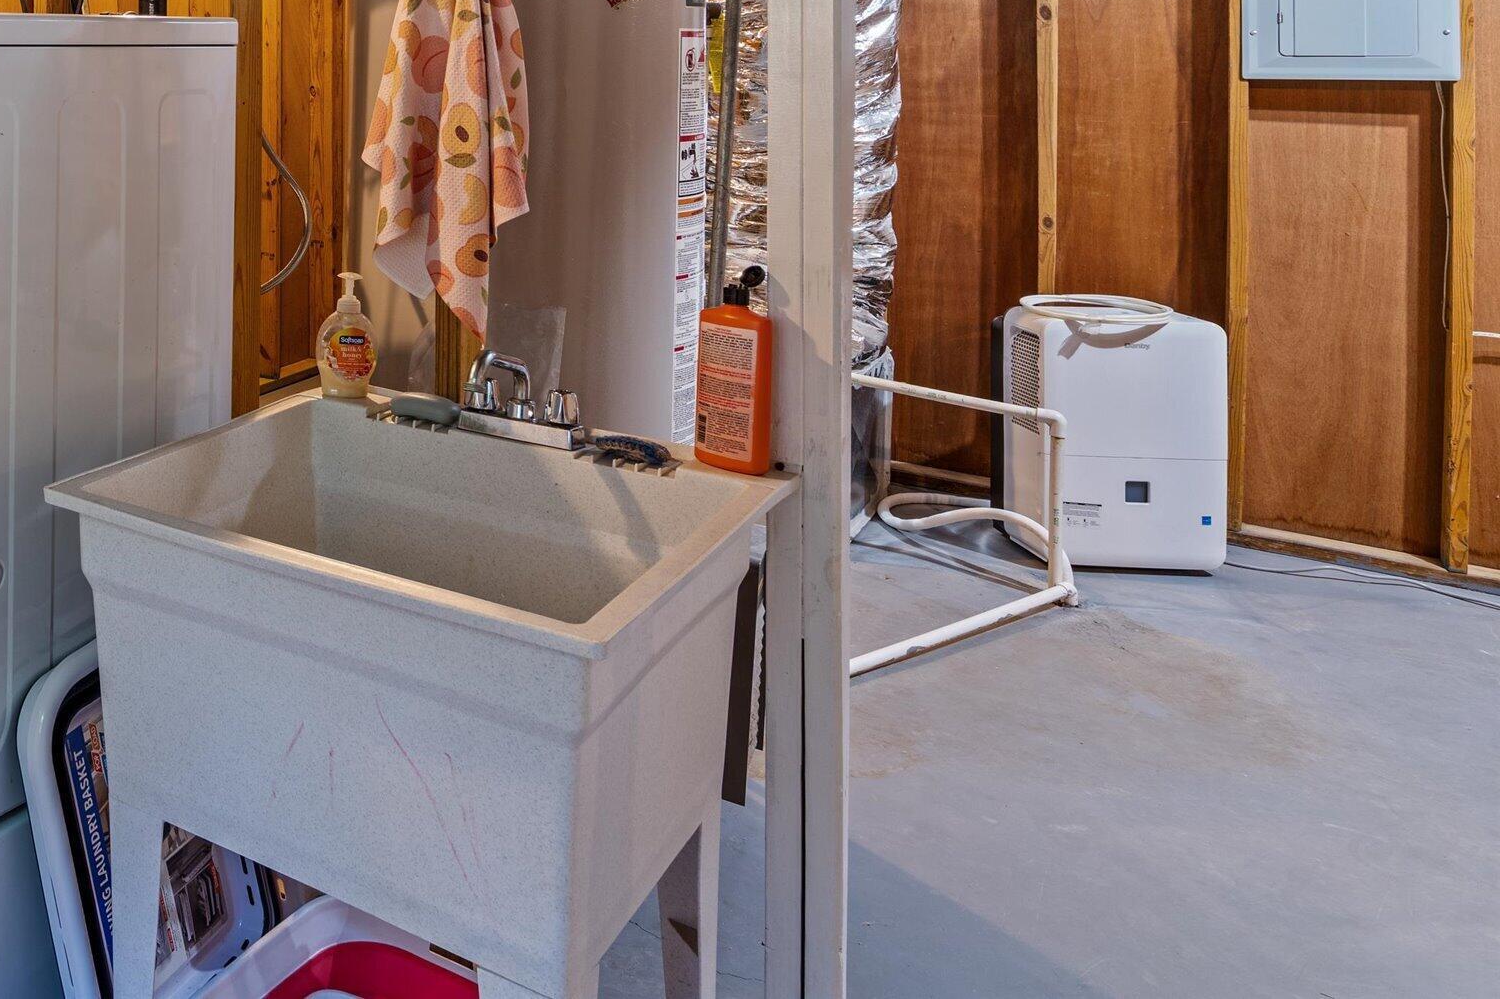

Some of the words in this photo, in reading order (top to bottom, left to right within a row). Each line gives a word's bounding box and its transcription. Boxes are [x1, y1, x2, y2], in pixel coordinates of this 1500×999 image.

[340, 336, 364, 344] Softsoap
[73, 748, 93, 811] BASKET
[87, 813, 109, 887] LAUNDRY
